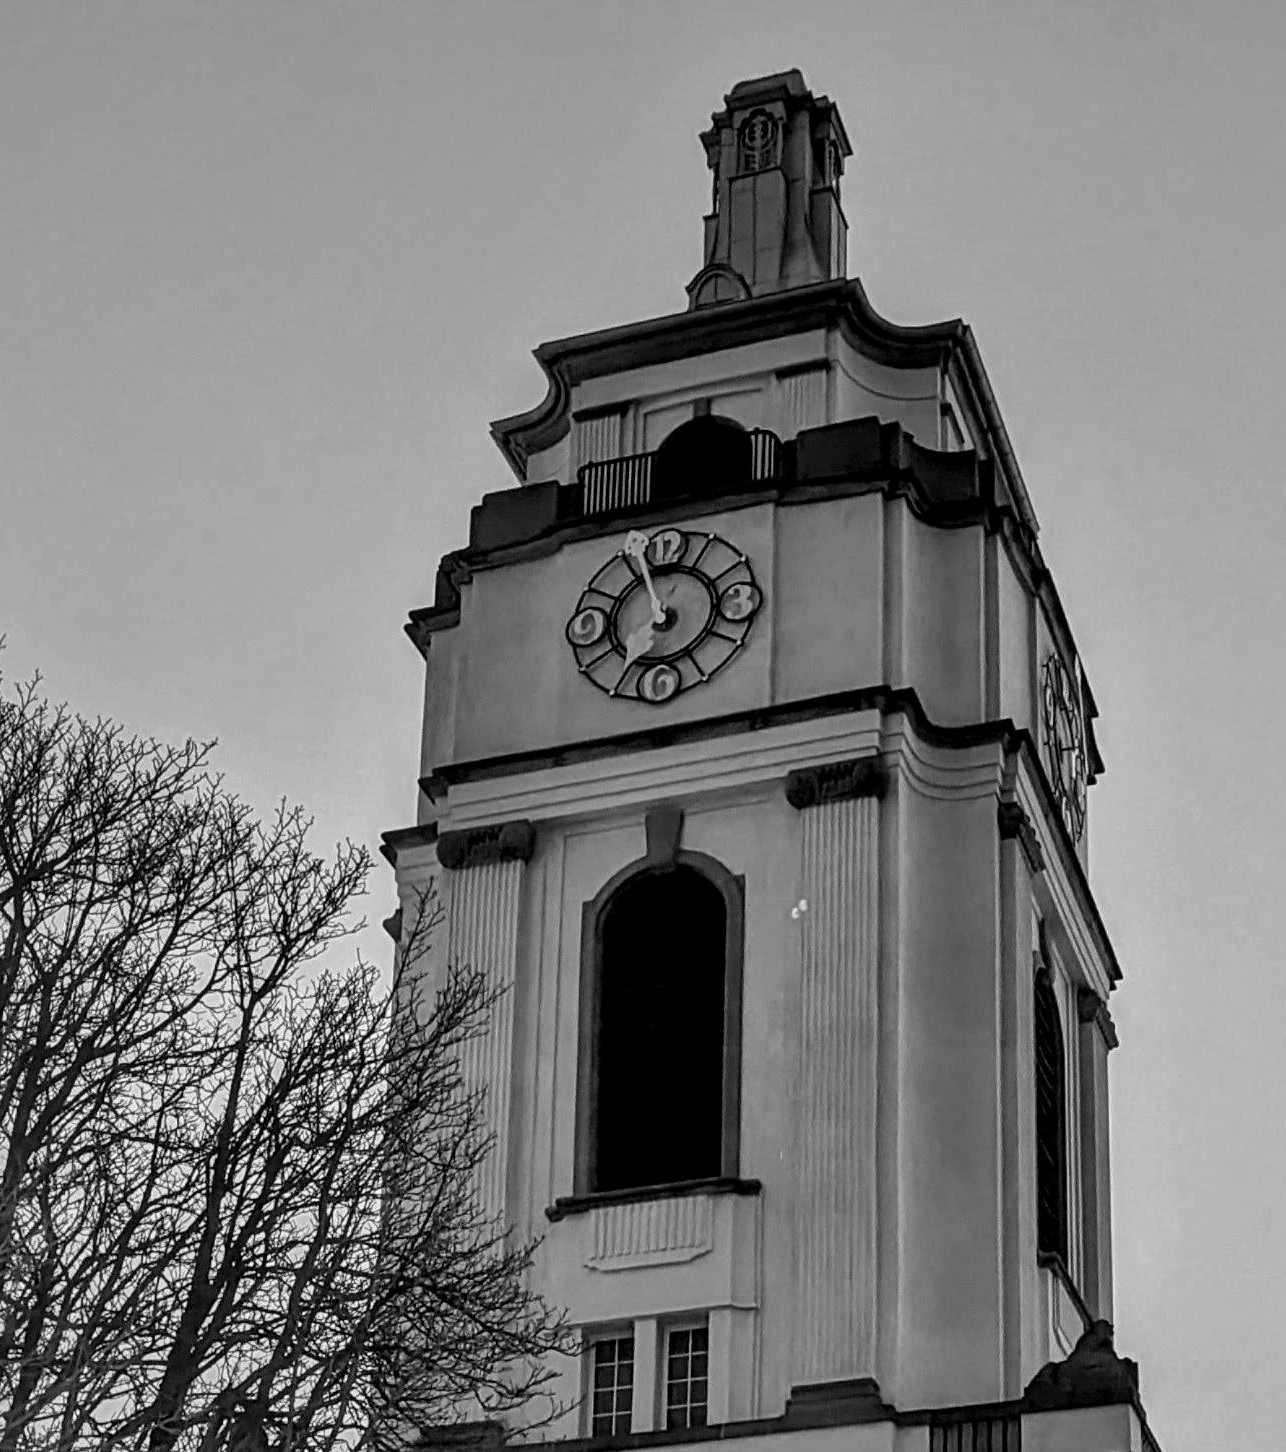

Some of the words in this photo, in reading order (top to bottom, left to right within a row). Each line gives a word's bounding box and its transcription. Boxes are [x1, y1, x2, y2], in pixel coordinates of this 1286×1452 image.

[652, 530, 681, 565] 12
[727, 584, 754, 621] 3
[572, 609, 606, 644] 9
[644, 664, 677, 701] 6
